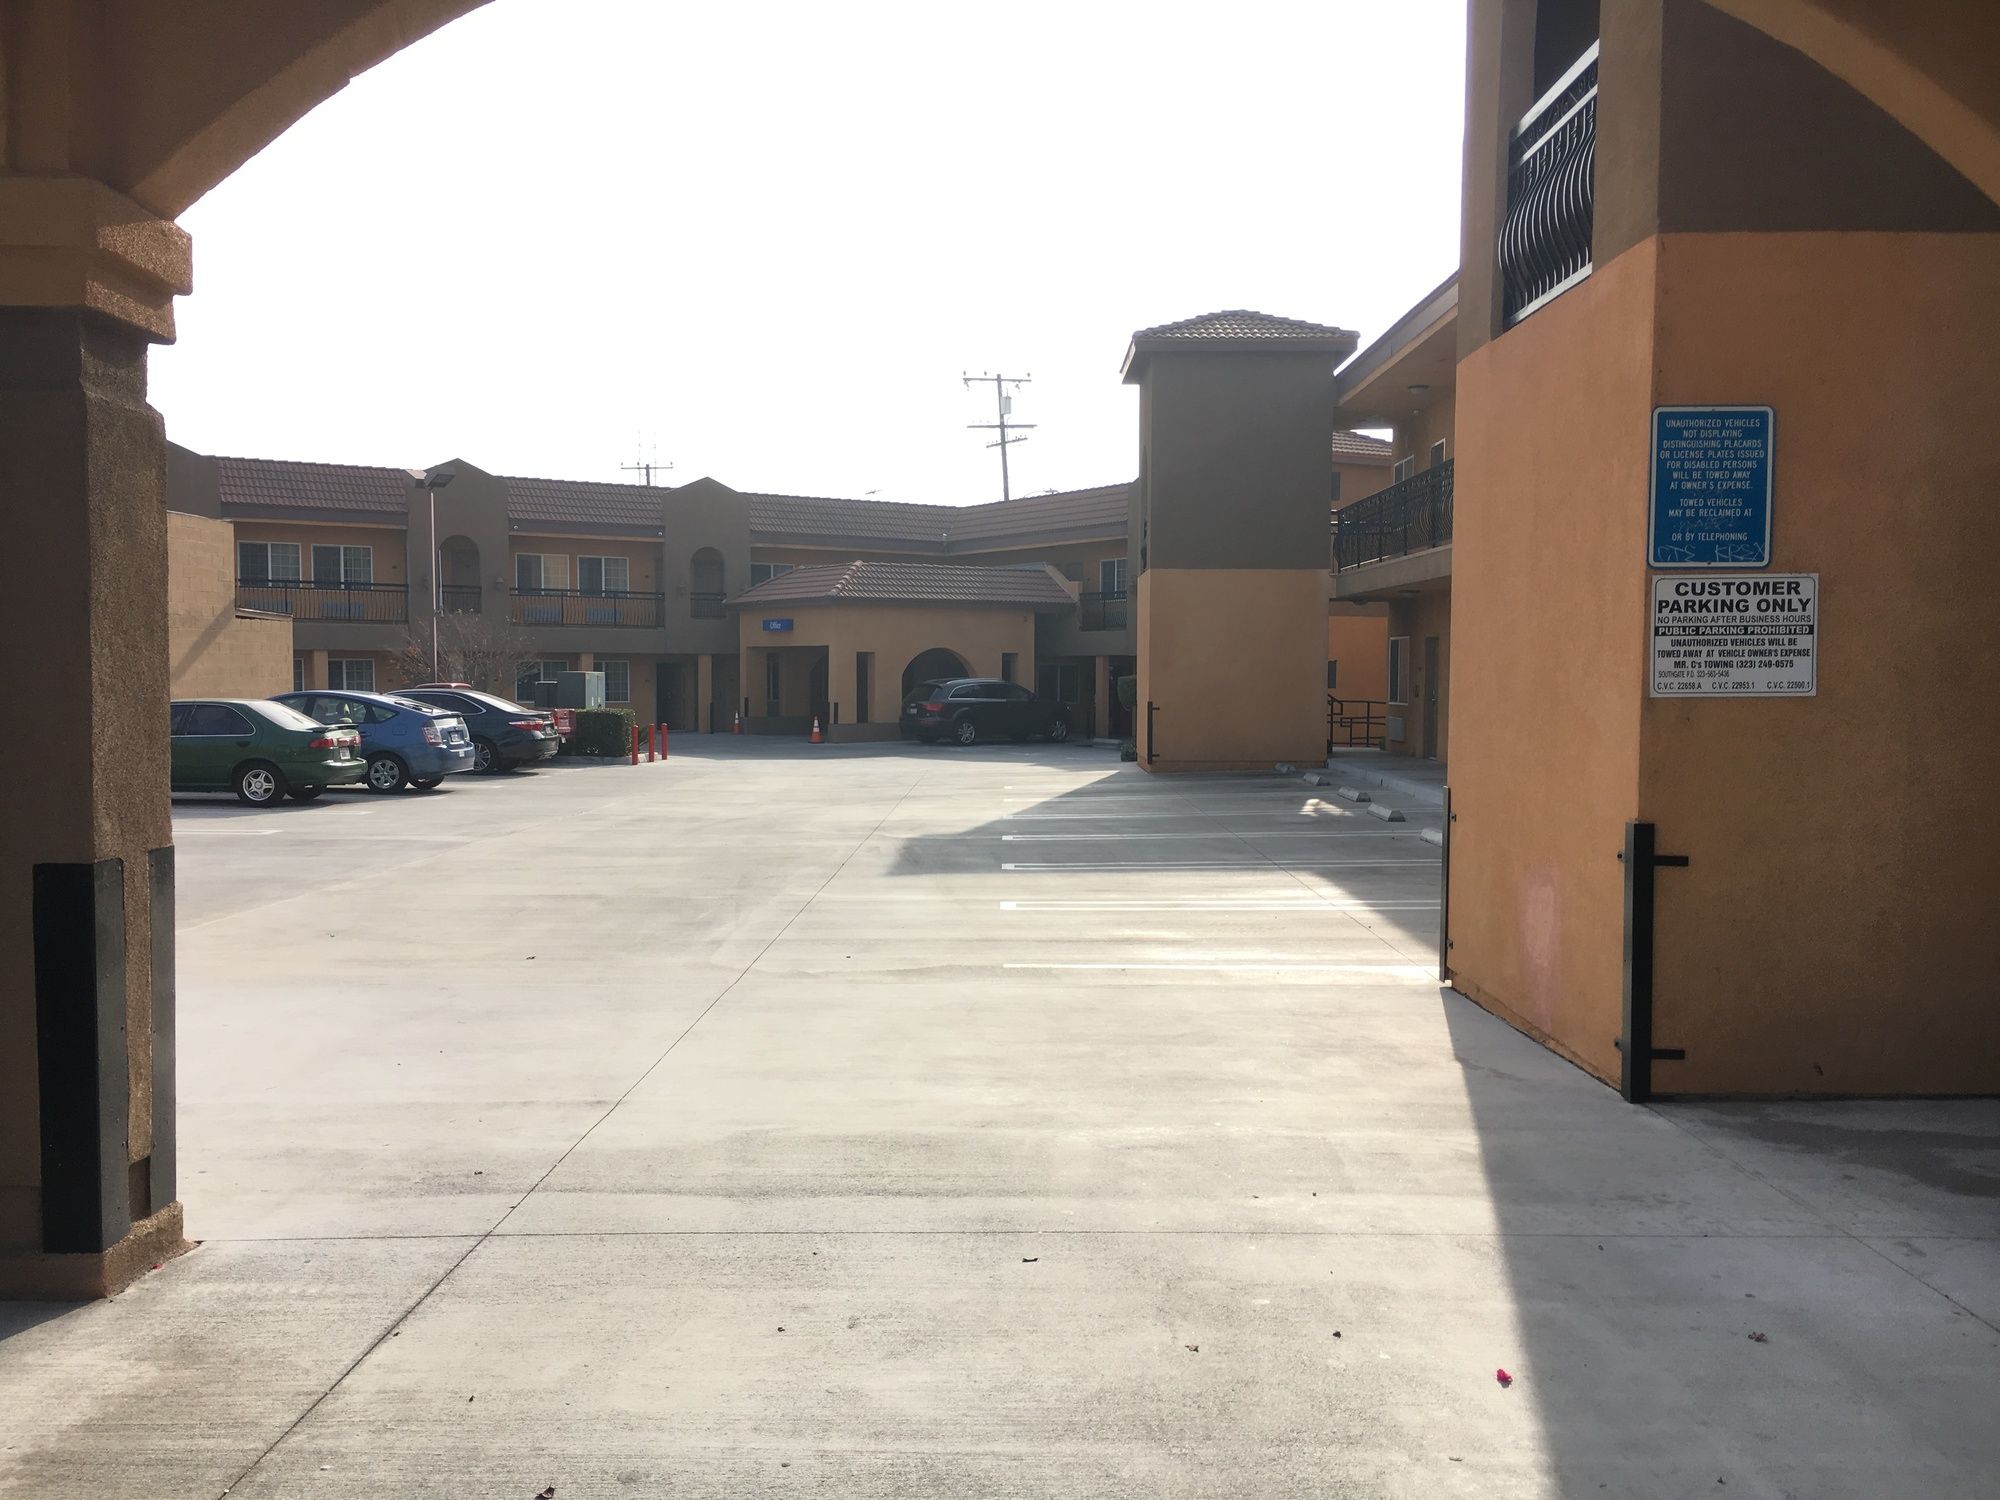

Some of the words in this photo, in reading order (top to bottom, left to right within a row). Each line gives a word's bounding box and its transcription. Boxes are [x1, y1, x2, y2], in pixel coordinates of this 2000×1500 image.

[1666, 419, 1722, 428] UNAUTHORIZED
[1724, 419, 1760, 427] VEHICLES
[1700, 429, 1743, 437] DISPLAYING
[1663, 440, 1722, 448] DISTINGUISHING
[1724, 440, 1762, 448] PLACARDS
[1660, 450, 1671, 459] OR
[1673, 450, 1704, 459] LICENSE
[1707, 450, 1735, 458] PLATES
[1737, 450, 1764, 458] ISSUED
[1667, 461, 1681, 469] FOR
[1684, 461, 1720, 469] DISABLED
[1723, 461, 1757, 469] PERSONS
[1673, 471, 1689, 479] WILL
[1693, 471, 1701, 479] BE
[1705, 471, 1730, 479] TOWED
[1670, 482, 1678, 490] AT
[1681, 481, 1715, 490] OWNER'S
[1680, 499, 1704, 507] TOWED
[1707, 498, 1743, 506] VEHICLES
[1668, 509, 1683, 517] MAY
[1685, 509, 1696, 517] BE
[1699, 508, 1741, 517] RECLAIMED
[1743, 508, 1752, 516] AT
[1672, 533, 1682, 541] OR
[1685, 533, 1695, 541] BY
[1698, 532, 1748, 541] TELEPHONING
[1675, 581, 1801, 596] CUSTOMER
[1657, 599, 1750, 614] PARKING
[1756, 598, 1811, 612] ONLY
[1657, 616, 1669, 624] NO
[1672, 615, 1708, 623] PARKING
[1710, 615, 1737, 623] AFTER
[1739, 615, 1780, 623] BUSINESS
[1782, 615, 1811, 623] HOURS
[1659, 626, 1697, 635] PUBLIC
[1699, 626, 1745, 635] PARKING
[1747, 626, 1810, 634] PROHIBITED
[1671, 639, 1728, 647] UNAUTHORIZED
[1730, 638, 1766, 646] VEHICLES
[1768, 638, 1786, 646] WILL
[1788, 638, 1798, 646] BE
[1657, 650, 1681, 658] TOWED
[1683, 649, 1702, 657] AWAY
[1706, 649, 1714, 657] AT
[1718, 649, 1746, 657] VEHICLE
[1747, 649, 1779, 657] OWNER'S
[1780, 648, 1810, 656] EXPENSE
[1674, 661, 1689, 669] MR.
[1691, 661, 1702, 669] C's
[1704, 660, 1734, 669] TOWING
[1736, 660, 1755, 669] (323)
[1658, 670, 1685, 678] SOUTHGATE
[1731, 681, 1755, 689] 22953.1
[1786, 680, 1810, 689] 22500.1
